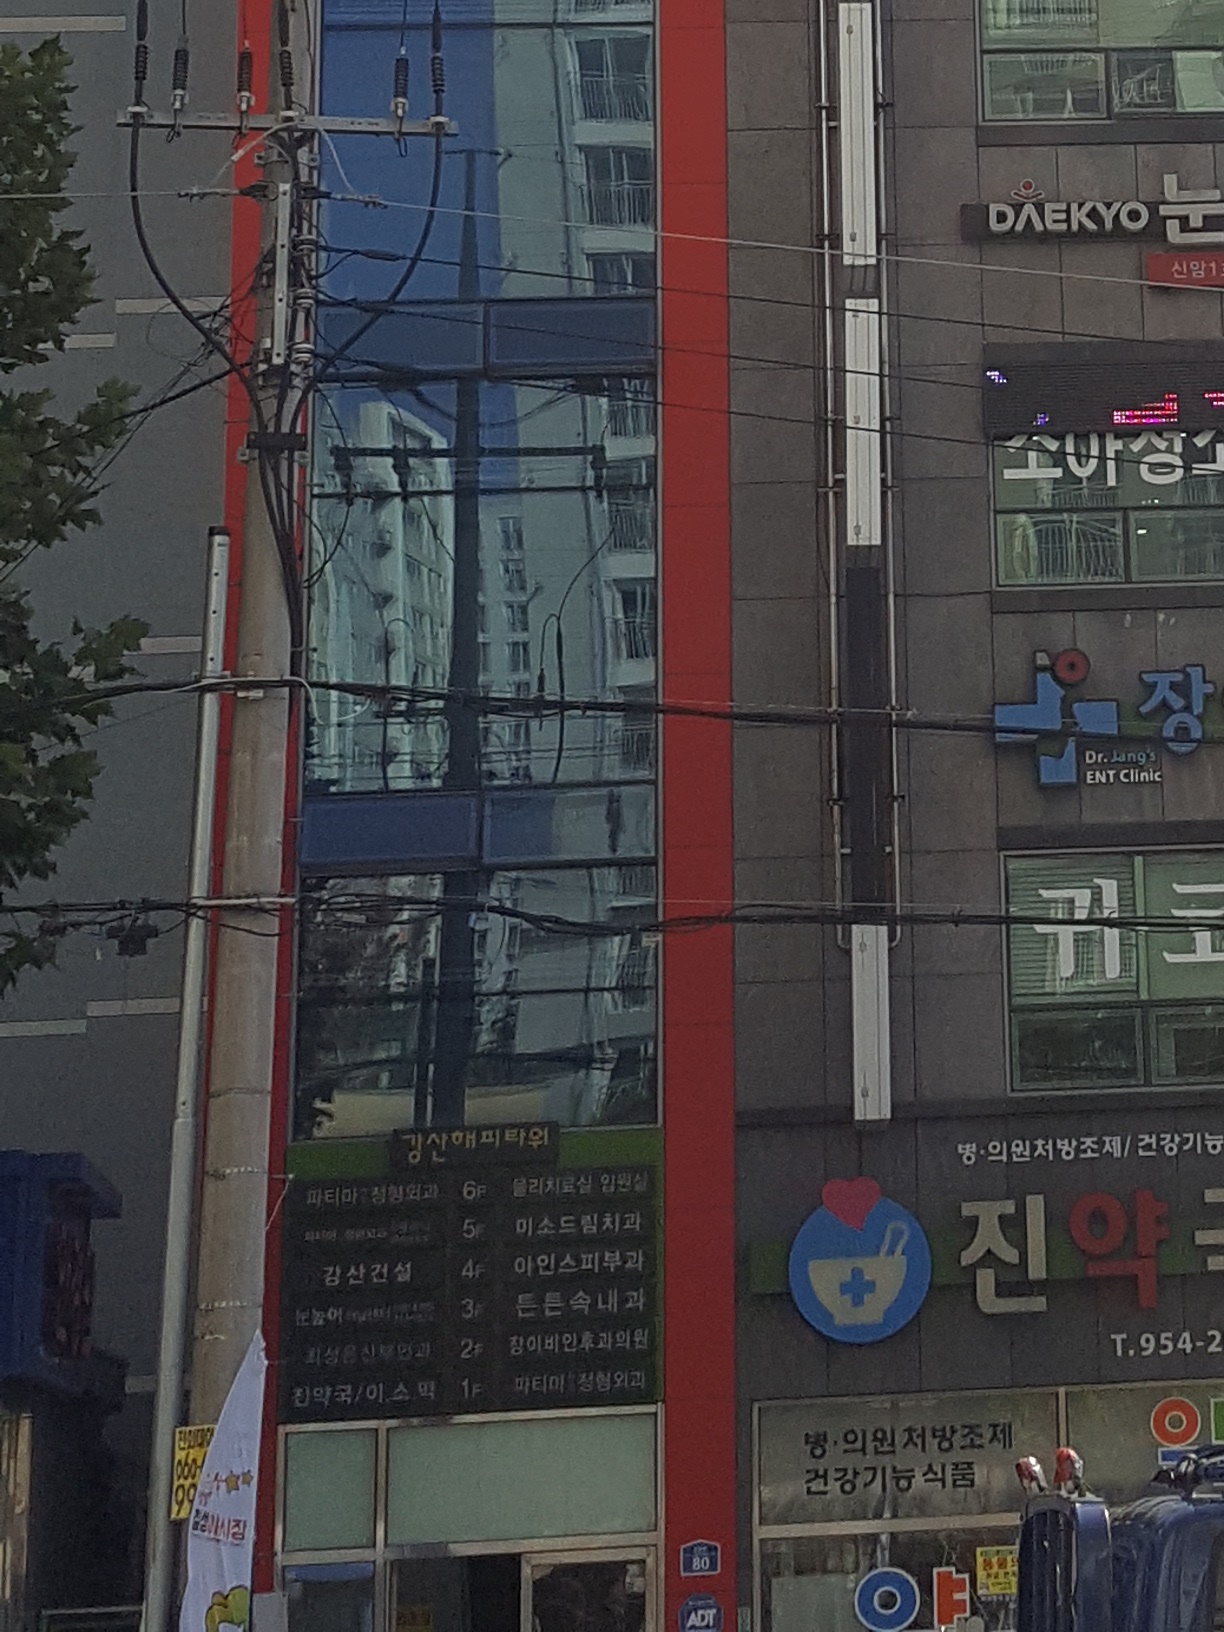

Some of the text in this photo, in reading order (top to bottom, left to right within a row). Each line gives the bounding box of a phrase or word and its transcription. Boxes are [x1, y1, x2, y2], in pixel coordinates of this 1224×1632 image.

[987, 200, 1150, 235] DAEKYO
[1085, 748, 1156, 766] Dr. Jang's
[1086, 768, 1162, 784] ENT Clinic
[803, 1460, 977, 1497] 건강기능식품
[686, 1607, 718, 1628] ADT
